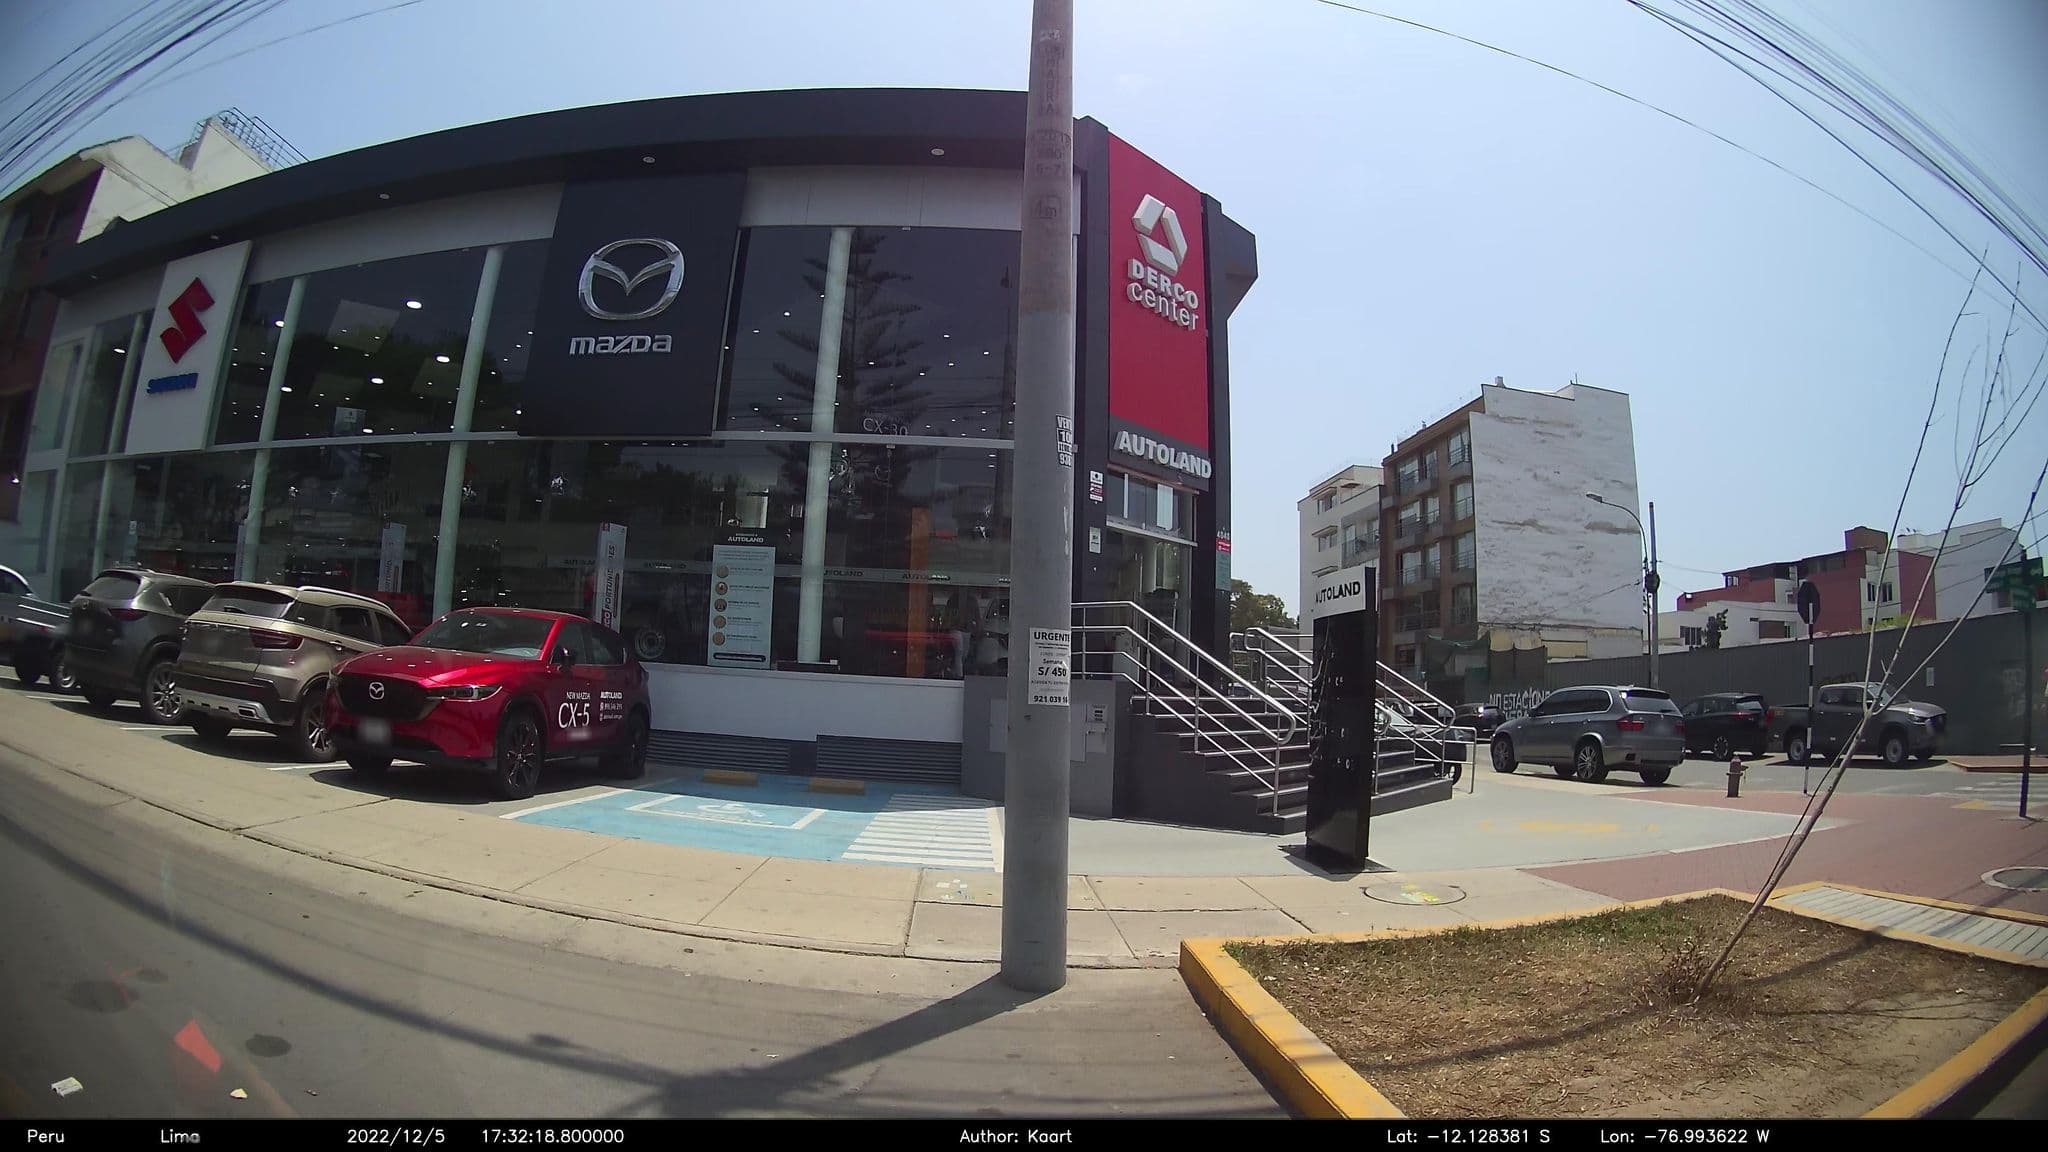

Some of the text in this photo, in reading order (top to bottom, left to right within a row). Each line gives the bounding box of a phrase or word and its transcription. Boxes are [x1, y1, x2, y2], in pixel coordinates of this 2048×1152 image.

[1128, 258, 1199, 310] DERCO
[1114, 430, 1212, 479] AUTOLAND
[1033, 631, 1070, 642] URGENT
[558, 702, 590, 728] CX-5
